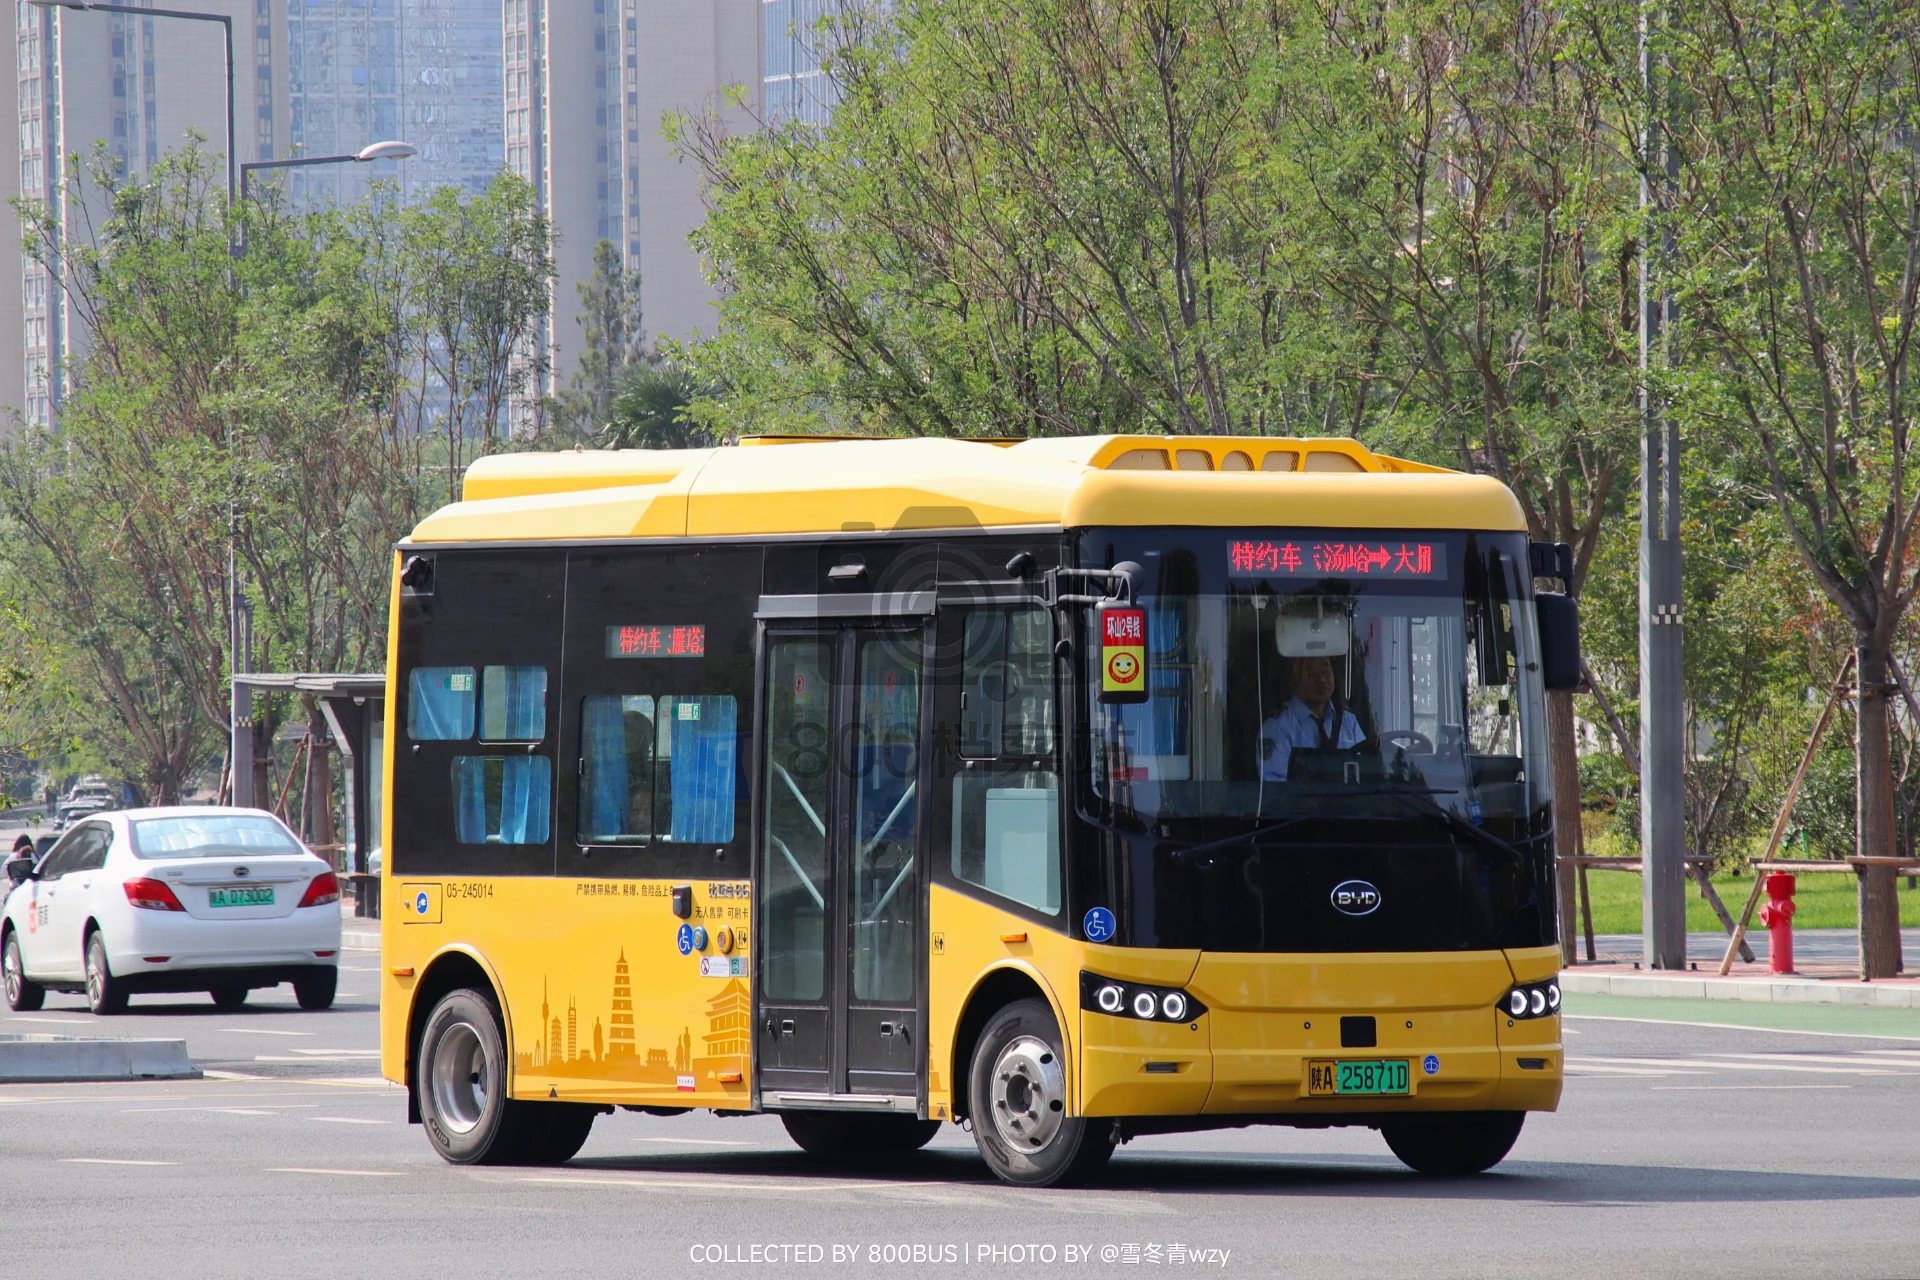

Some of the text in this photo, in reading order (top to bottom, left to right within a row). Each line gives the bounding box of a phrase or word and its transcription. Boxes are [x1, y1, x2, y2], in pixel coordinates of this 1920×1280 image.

[1232, 542, 1302, 572] 特约车
[1107, 616, 1141, 639] 环山2号线
[620, 627, 662, 655] 特约车
[446, 883, 493, 898] 05-245014
[1338, 892, 1376, 904] BYD
[695, 906, 749, 920] 无人售票 可刷卡
[1311, 1065, 1407, 1090] 陕A 25871D
